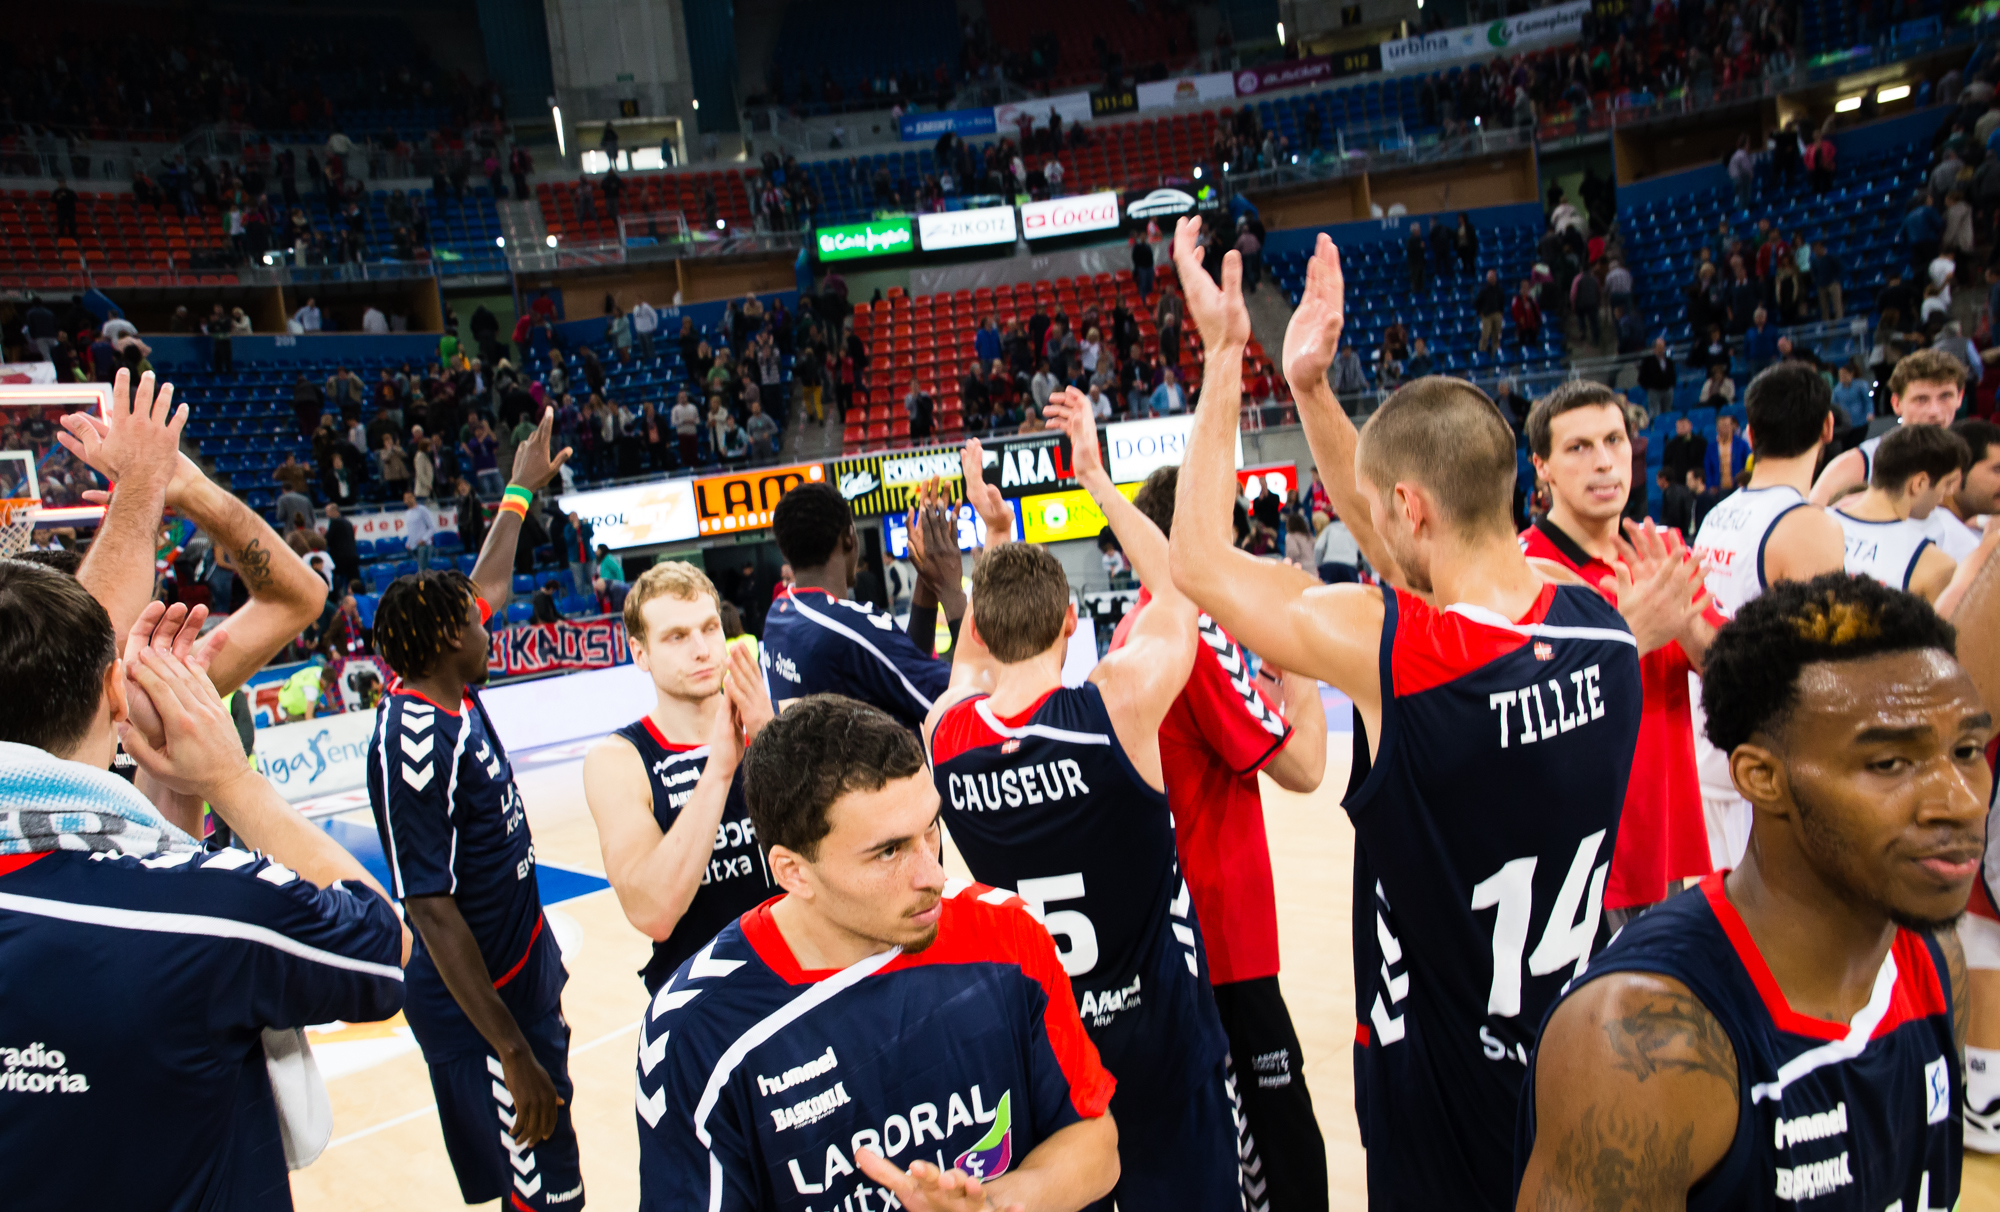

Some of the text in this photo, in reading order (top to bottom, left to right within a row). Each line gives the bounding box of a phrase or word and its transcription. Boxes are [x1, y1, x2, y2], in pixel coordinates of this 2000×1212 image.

[1489, 663, 1605, 749] TILLIE
[327, 734, 371, 764] end
[948, 758, 1090, 812] CAUSEUR
[700, 854, 753, 886] utxa
[1017, 872, 1099, 977] 5
[1471, 828, 1610, 1018] 14
[756, 1046, 838, 1097] hummel
[770, 1081, 852, 1133] BASKONIA
